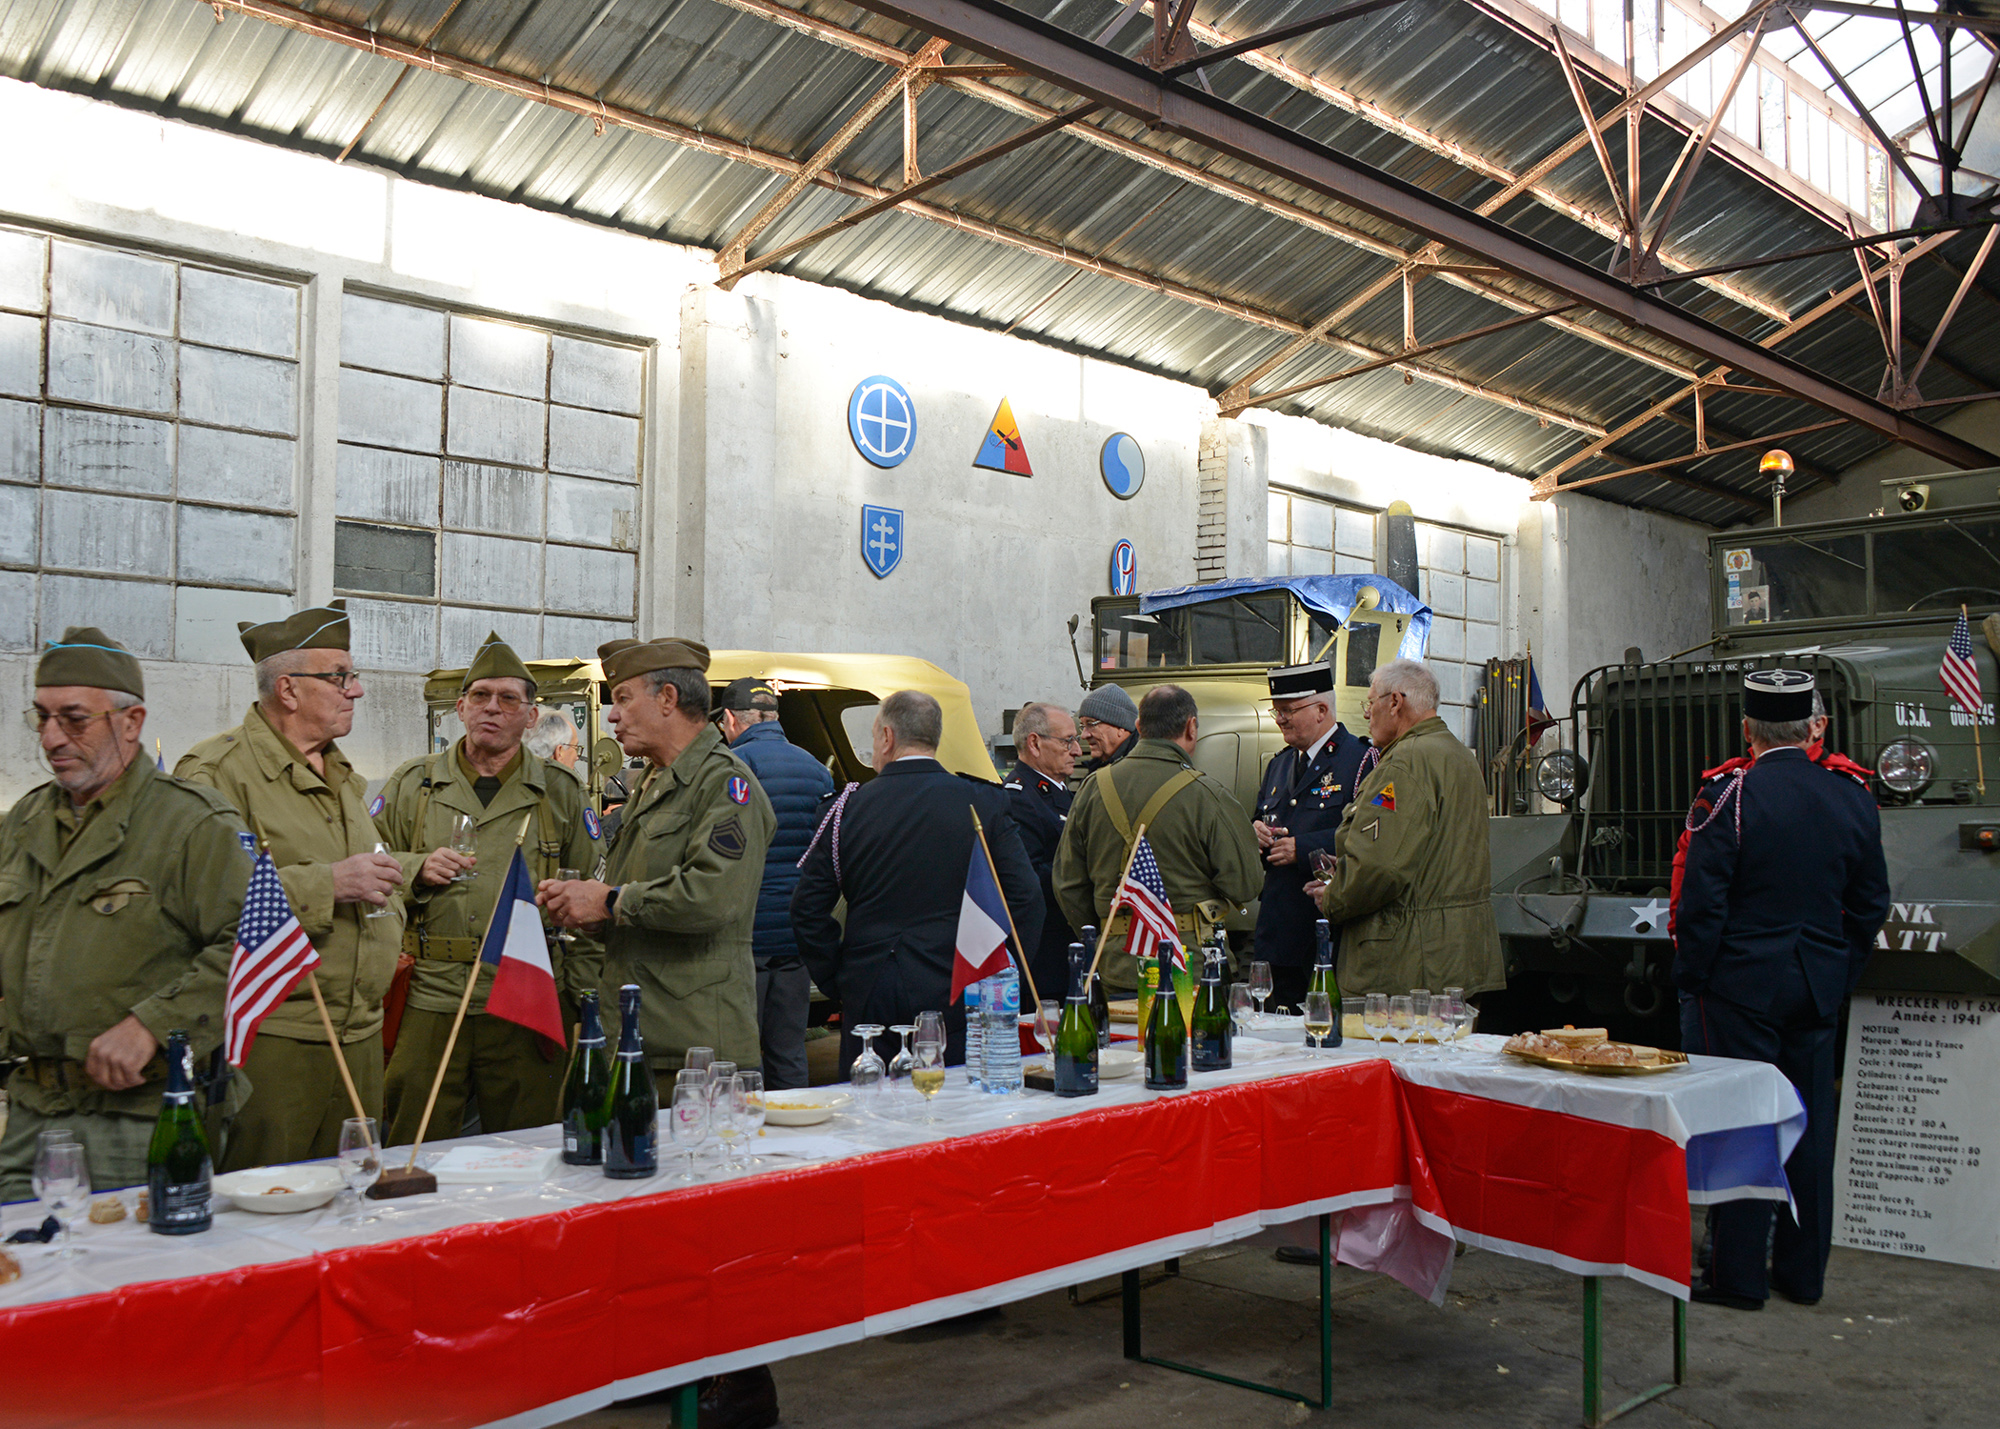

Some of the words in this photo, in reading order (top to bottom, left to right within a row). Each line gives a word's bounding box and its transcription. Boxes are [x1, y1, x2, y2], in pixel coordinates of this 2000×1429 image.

[1694, 663, 1738, 673] PSTONE
[1895, 701, 1931, 728] U.S.A.
[1886, 903, 1936, 924] NK
[1873, 930, 1948, 952] ATT
[1875, 996, 1940, 1009] WRECKER
[1946, 999, 1959, 1010] 10
[1966, 1000, 1973, 1010] T
[1892, 1010, 1937, 1023] Année
[1953, 1013, 1981, 1025] 1941
[1862, 1025, 1899, 1034] MOTEUR
[1861, 1036, 1892, 1046] Marque
[1900, 1038, 1921, 1047] Ward
[1925, 1040, 1933, 1048] la
[1935, 1040, 1964, 1050] France
[1860, 1046, 1880, 1056] Type
[1889, 1048, 1909, 1057] 1000
[1912, 1050, 1933, 1058] série
[1859, 1057, 1880, 1067] Cycle
[1897, 1061, 1922, 1070] temps
[1857, 1069, 1896, 1080] Cylindres
[1926, 1074, 1948, 1084] ligne
[1856, 1081, 1899, 1092] Carburant
[1907, 1087, 1940, 1095] essence
[1856, 1090, 1888, 1101] Alésage
[1855, 1101, 1894, 1112] Cylindrée
[1853, 1113, 1888, 1124] Batterie
[1896, 1117, 1906, 1125] 12
[1939, 1121, 1947, 1129] A
[1852, 1124, 1917, 1137] Consommation
[1920, 1132, 1959, 1142] moyenne
[1879, 1138, 1908, 1148] charge
[1911, 1141, 1959, 1153] remorquée
[1968, 1146, 1980, 1155] 80
[1857, 1148, 1875, 1156] sans
[1878, 1149, 1907, 1160] charge
[1910, 1153, 1958, 1164] remorquée
[1967, 1158, 1980, 1167] 60
[1849, 1156, 1873, 1167] Pente
[1876, 1161, 1919, 1171] maximum
[1928, 1165, 1940, 1174] 60
[1849, 1167, 1874, 1178] Angle
[1848, 1178, 1879, 1190] TREUIL
[1852, 1192, 1876, 1201] avant
[1879, 1193, 1901, 1204] force
[1851, 1203, 1881, 1213] arrière
[1884, 1205, 1907, 1216] force
[1844, 1213, 1867, 1223] Poids
[1857, 1226, 1876, 1236] vide
[1880, 1229, 1906, 1239] 12940
[1861, 1238, 1890, 1249] charge
[1900, 1242, 1926, 1253] 15930
